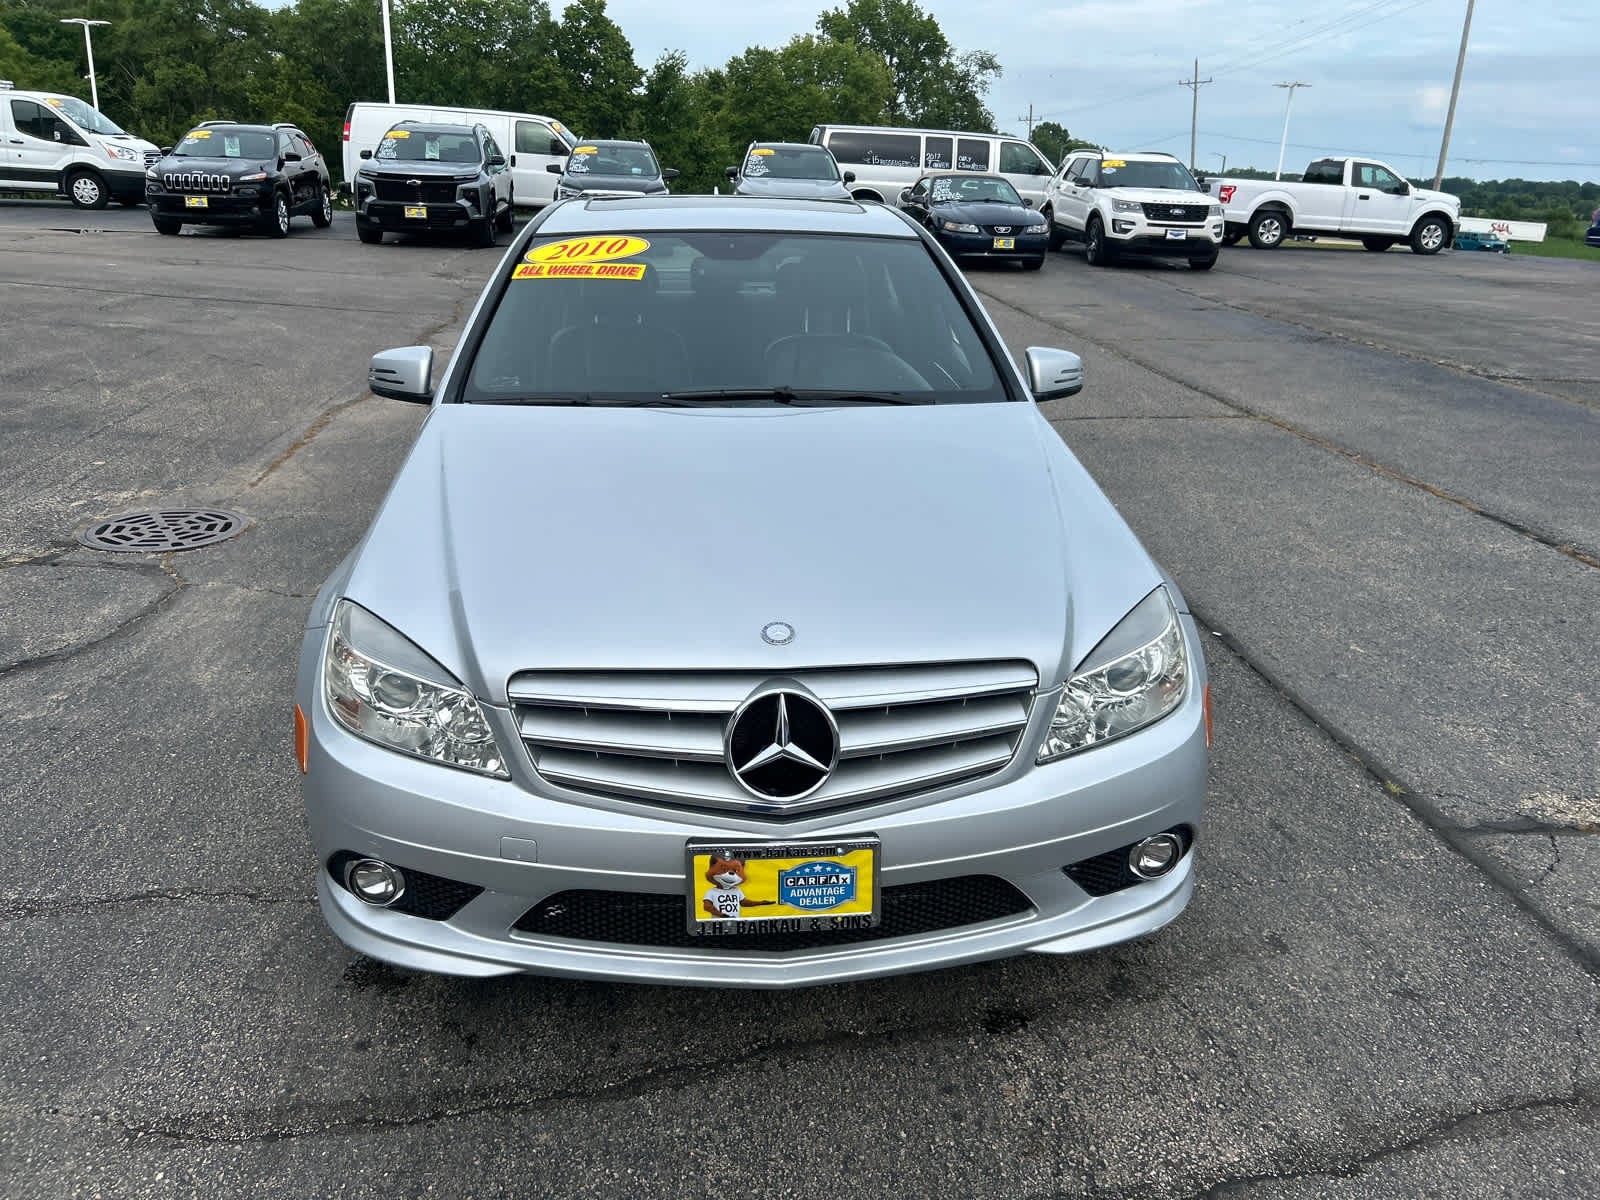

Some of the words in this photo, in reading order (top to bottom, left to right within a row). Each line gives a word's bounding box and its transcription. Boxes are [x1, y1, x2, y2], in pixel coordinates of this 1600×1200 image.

[544, 239, 629, 261] 2010
[517, 265, 545, 277] ALL
[547, 265, 594, 276] WHEEL
[596, 265, 641, 277] DRIVE
[733, 846, 838, 860] www.barkau.com
[785, 875, 851, 887] CARFAX
[790, 887, 846, 897] ADVANTAGE
[717, 895, 738, 904] CAR
[799, 896, 836, 906] DEALER
[719, 903, 738, 913] FOX
[696, 922, 729, 936] J.H.
[737, 919, 801, 936] BARKAU
[810, 919, 821, 932] &
[830, 915, 872, 930] SONS
